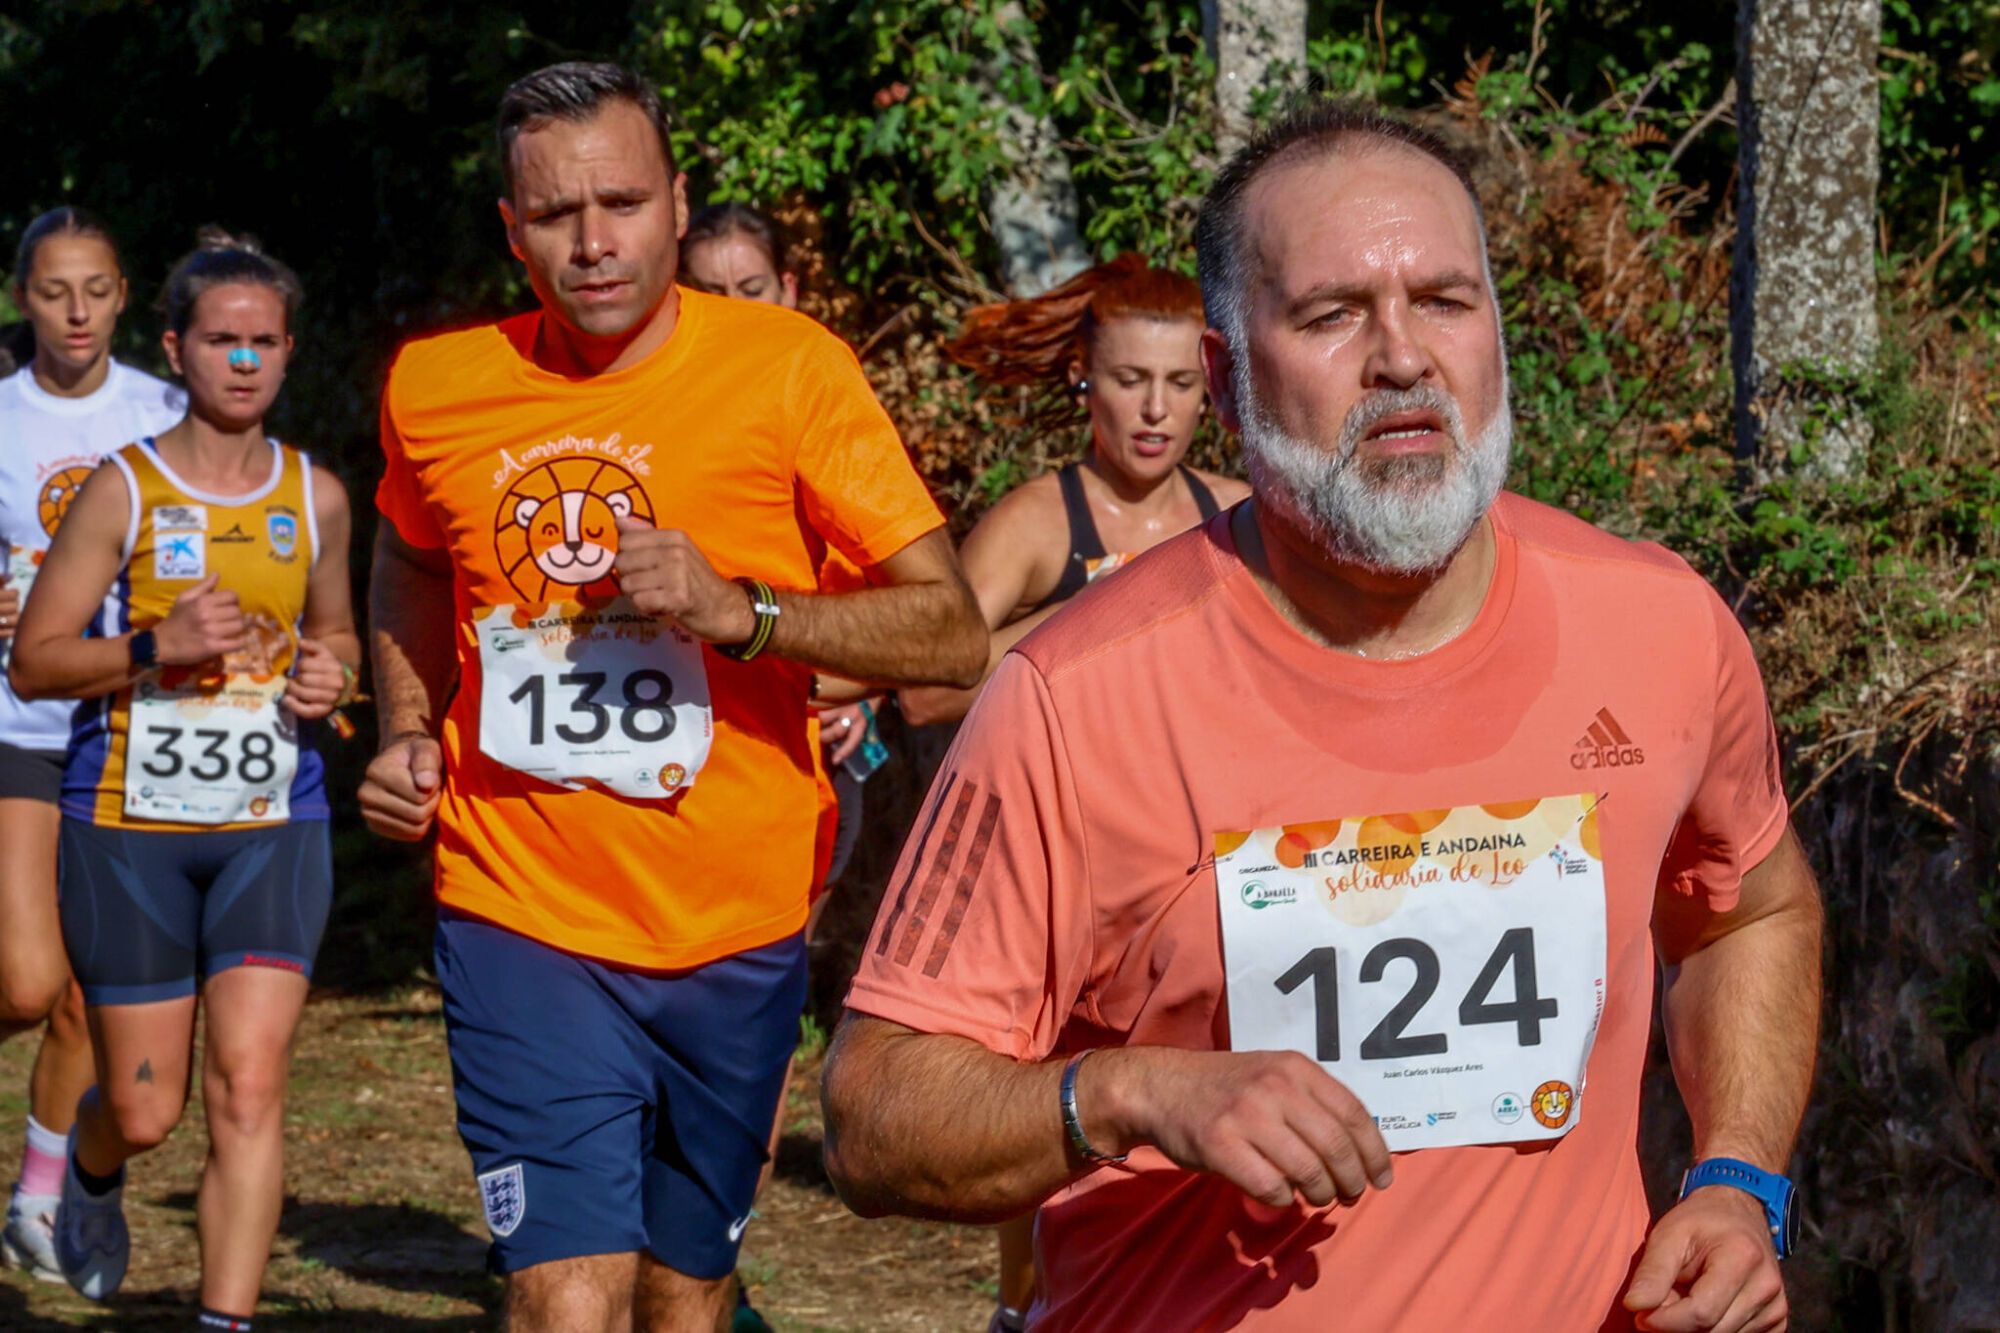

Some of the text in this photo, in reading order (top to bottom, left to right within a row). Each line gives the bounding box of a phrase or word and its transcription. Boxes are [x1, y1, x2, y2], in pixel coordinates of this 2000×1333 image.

[492, 448, 525, 489] A
[600, 432, 622, 456] de
[621, 443, 653, 476] Leo
[509, 669, 677, 745] 138
[142, 726, 275, 784] 338
[1570, 745, 1645, 770] adidas
[1304, 833, 1526, 868] III CARREIRA E ANDAINA
[1325, 851, 1528, 900] solidaria de Leo
[1274, 926, 1558, 1062] 124
[1383, 1070, 1402, 1079] Juan
[1404, 1068, 1428, 1077] Carlos
[1465, 1063, 1484, 1071] Ares
